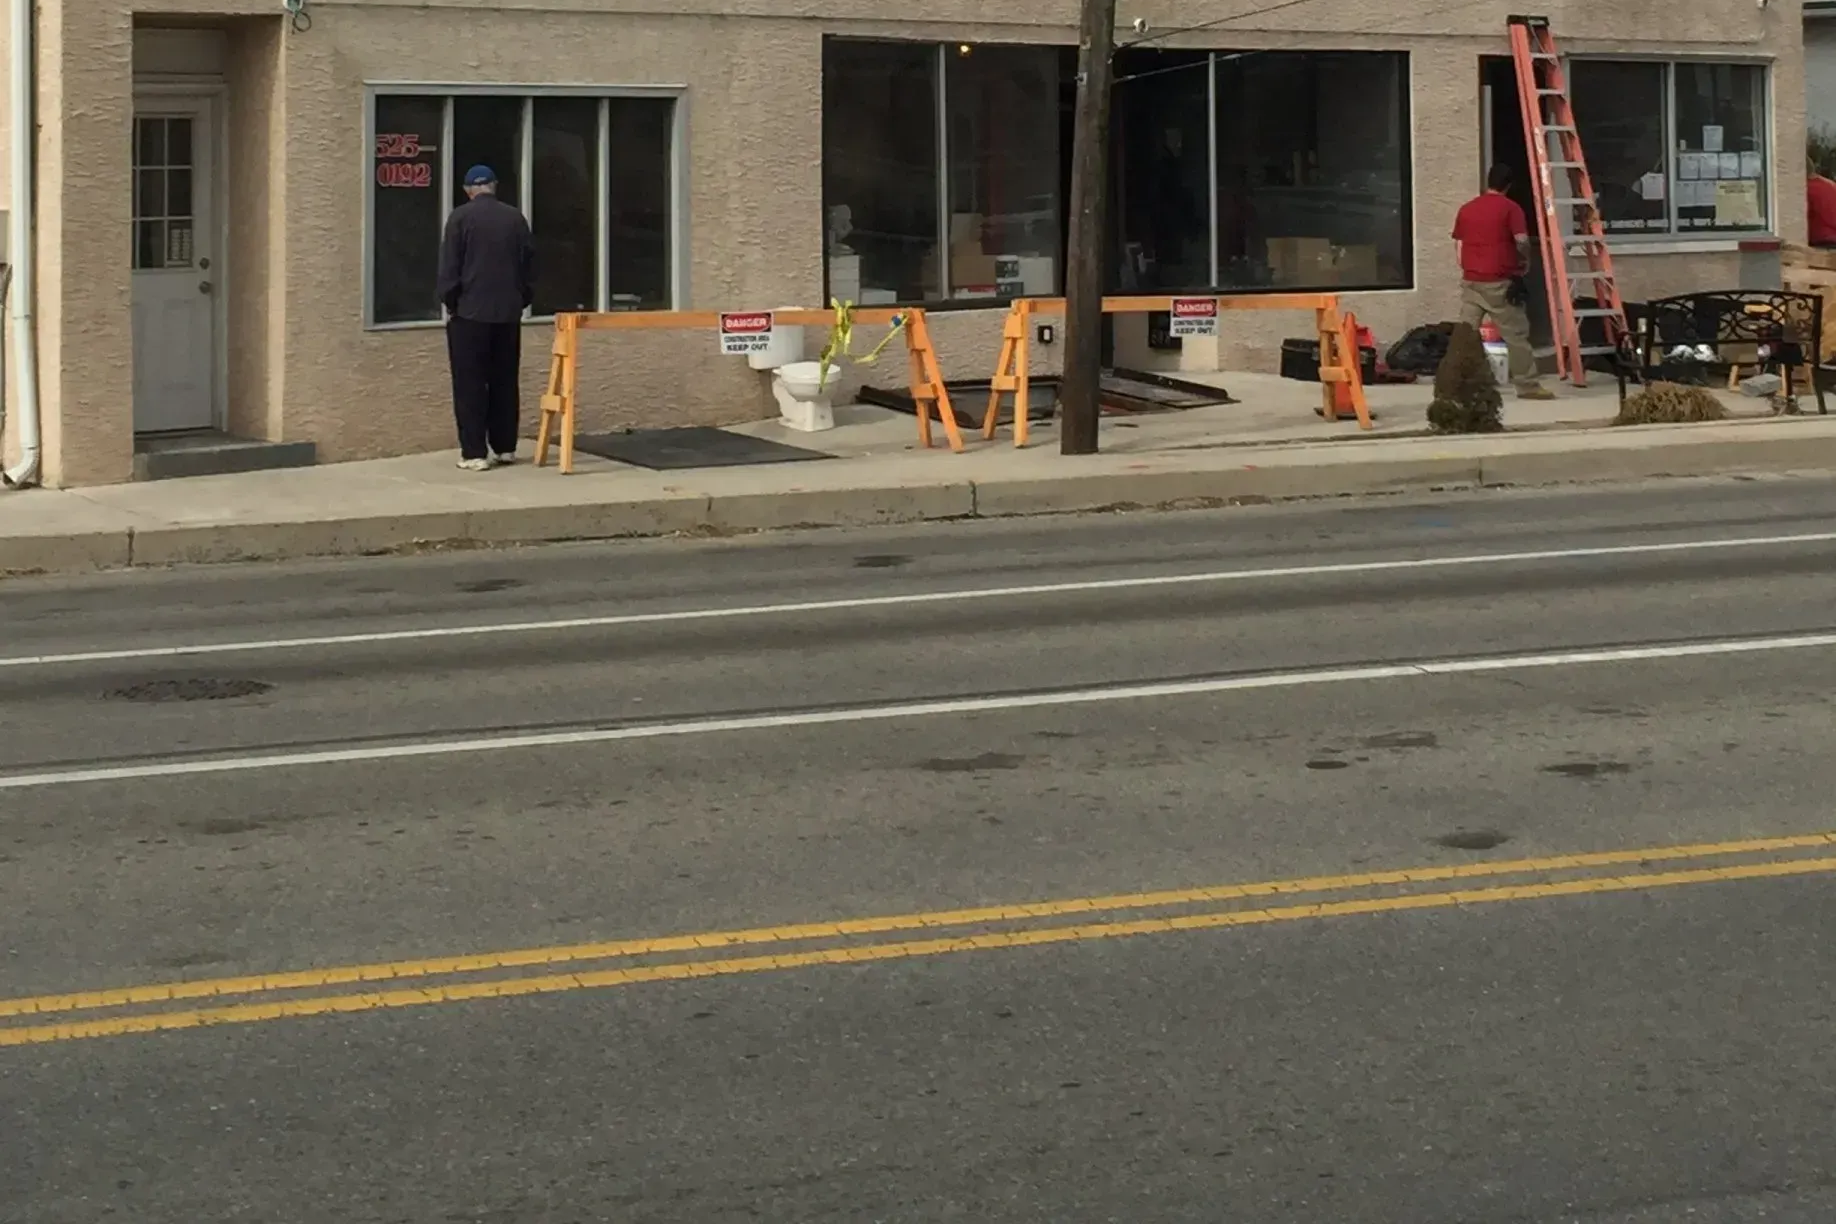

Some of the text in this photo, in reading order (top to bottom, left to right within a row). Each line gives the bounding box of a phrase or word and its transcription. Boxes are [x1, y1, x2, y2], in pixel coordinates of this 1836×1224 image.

[377, 163, 432, 187] 0192
[1176, 304, 1213, 312] DANGER
[726, 318, 766, 328] DANGER
[726, 343, 768, 352] KEEP OUT
